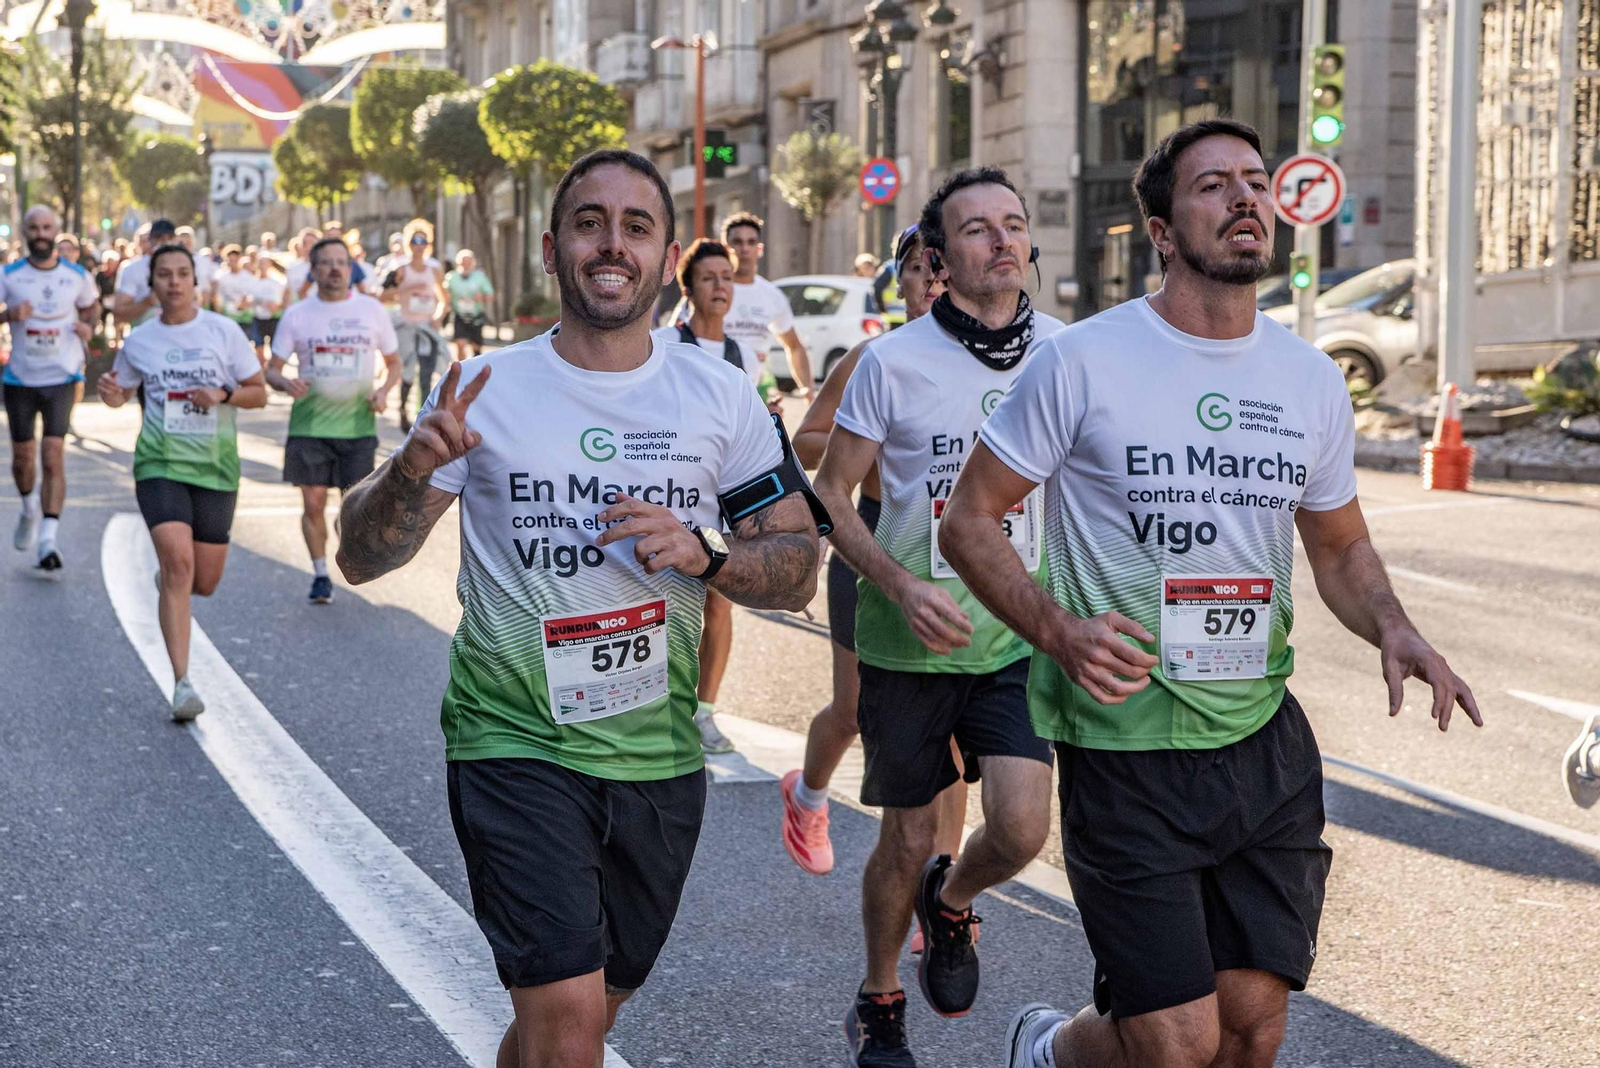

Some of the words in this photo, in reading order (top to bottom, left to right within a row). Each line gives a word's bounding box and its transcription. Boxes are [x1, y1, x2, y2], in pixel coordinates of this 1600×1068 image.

[1238, 398, 1284, 414] asociación
[1239, 410, 1279, 424] española
[623, 430, 678, 439] asociación
[1239, 422, 1269, 433] contra
[1269, 426, 1278, 435] el
[1278, 427, 1305, 440] cáncer
[624, 442, 670, 451] española
[932, 434, 964, 456] En
[624, 453, 657, 461] contra
[659, 453, 669, 461] el
[671, 453, 702, 464] cáncer
[1126, 445, 1174, 476] En
[1186, 445, 1307, 488] Marcha
[509, 472, 555, 503] En
[568, 473, 701, 509] Marcha
[1127, 486, 1195, 503] contra
[1201, 486, 1218, 504] el
[1220, 488, 1287, 510] cáncer
[512, 512, 578, 530] contra
[582, 512, 601, 531] el
[1127, 511, 1218, 555] Vigo
[513, 537, 605, 578] Vigo
[1176, 598, 1191, 606] Vigo
[1204, 608, 1256, 636] 579
[558, 639, 574, 647] Vigo
[584, 633, 610, 643] marcha
[610, 629, 632, 639] contra
[637, 622, 657, 633] cancro
[591, 634, 652, 672] 578
